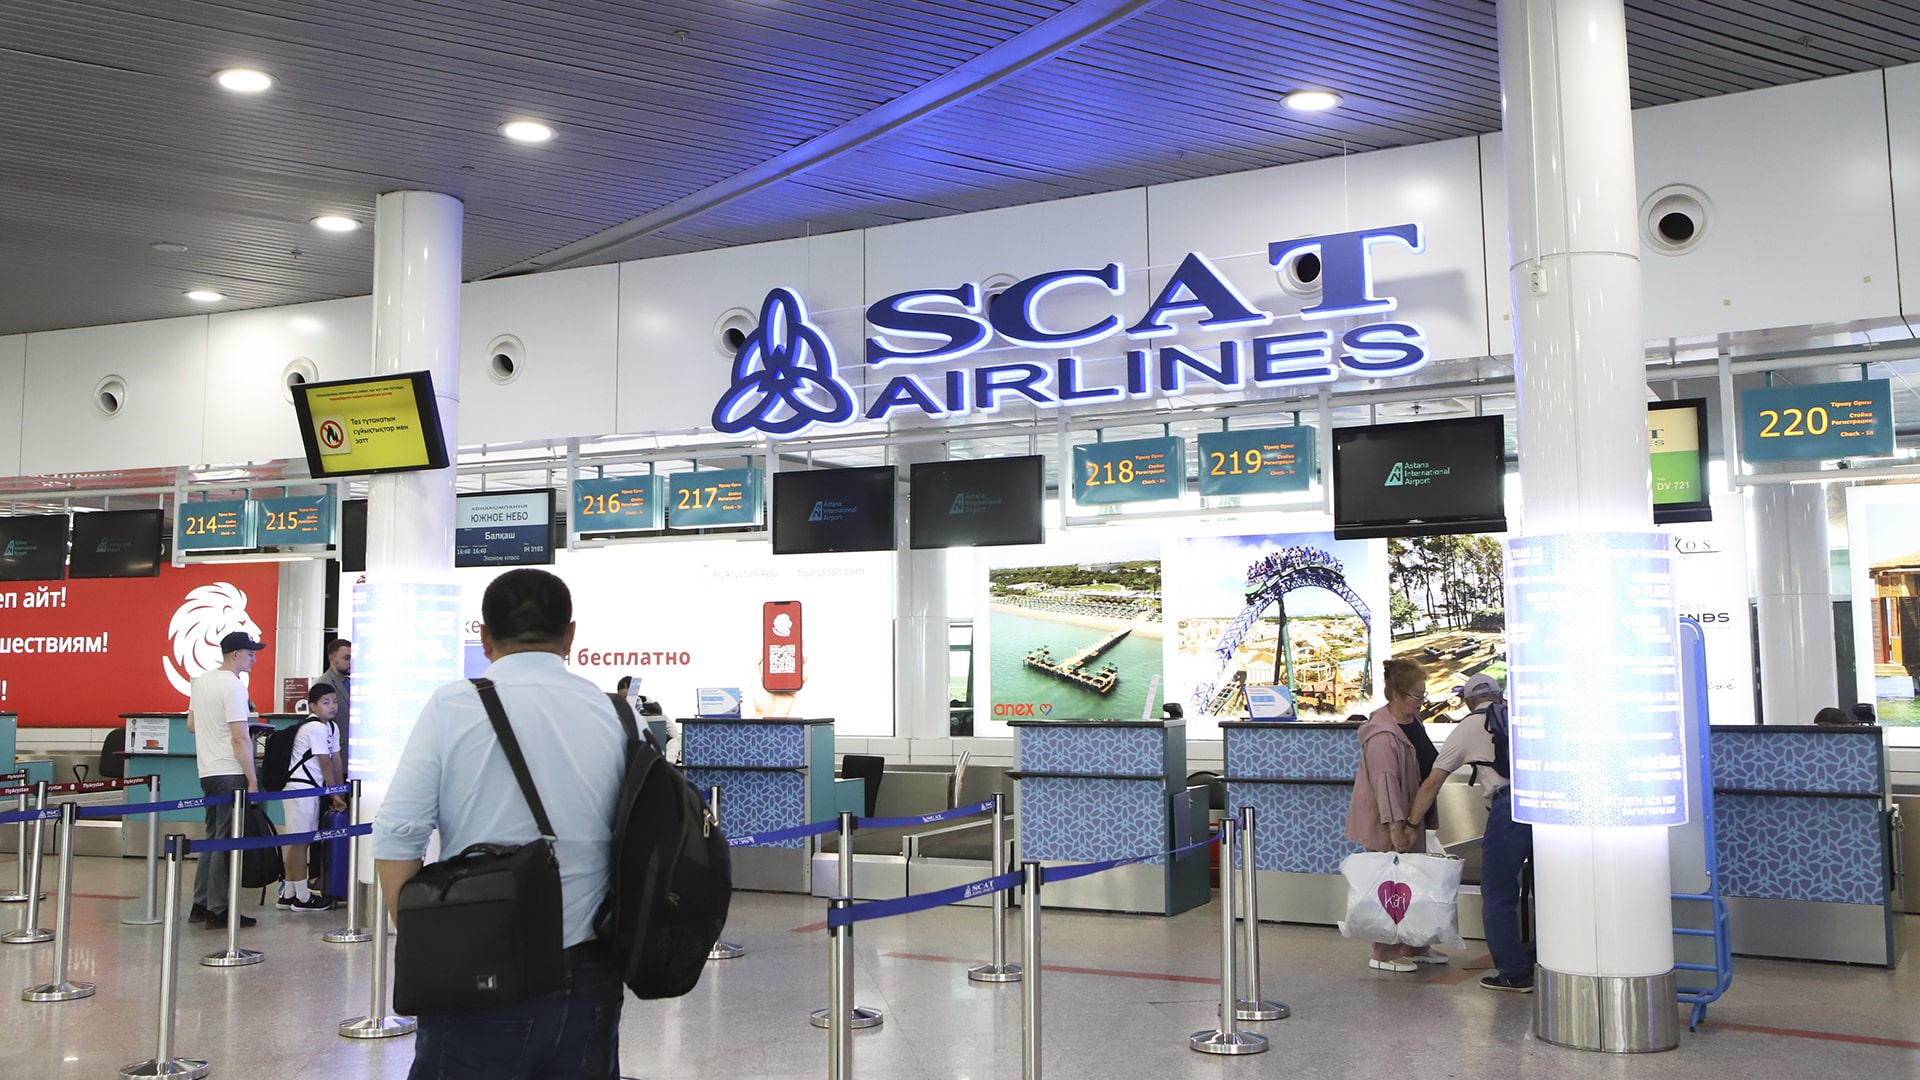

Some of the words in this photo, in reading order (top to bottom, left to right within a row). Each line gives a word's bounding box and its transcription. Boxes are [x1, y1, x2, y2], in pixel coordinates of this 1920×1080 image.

[866, 223, 1425, 366] SCAT
[864, 322, 1431, 425] AIRLINES
[1759, 406, 1829, 438] 220
[1085, 459, 1134, 486] 218
[1210, 449, 1262, 476] 219
[1404, 477, 1430, 486] Airport
[1657, 482, 1671, 490] DV
[1674, 481, 1690, 489] 721
[471, 503, 528, 511] АВИАКОМПАНИЯ
[582, 493, 621, 515] 216
[677, 487, 718, 510] 217
[185, 515, 217, 535] 214
[265, 511, 299, 531] 215
[470, 513, 503, 523] ЮЖНОЕ
[505, 511, 529, 521] НЕБО
[485, 531, 516, 541] Балқаш
[23, 586, 67, 608] айт!
[577, 648, 691, 666] бесплатно
[993, 704, 1035, 717] anex
[972, 880, 994, 891] SCAT
[1384, 888, 1407, 910] kari
